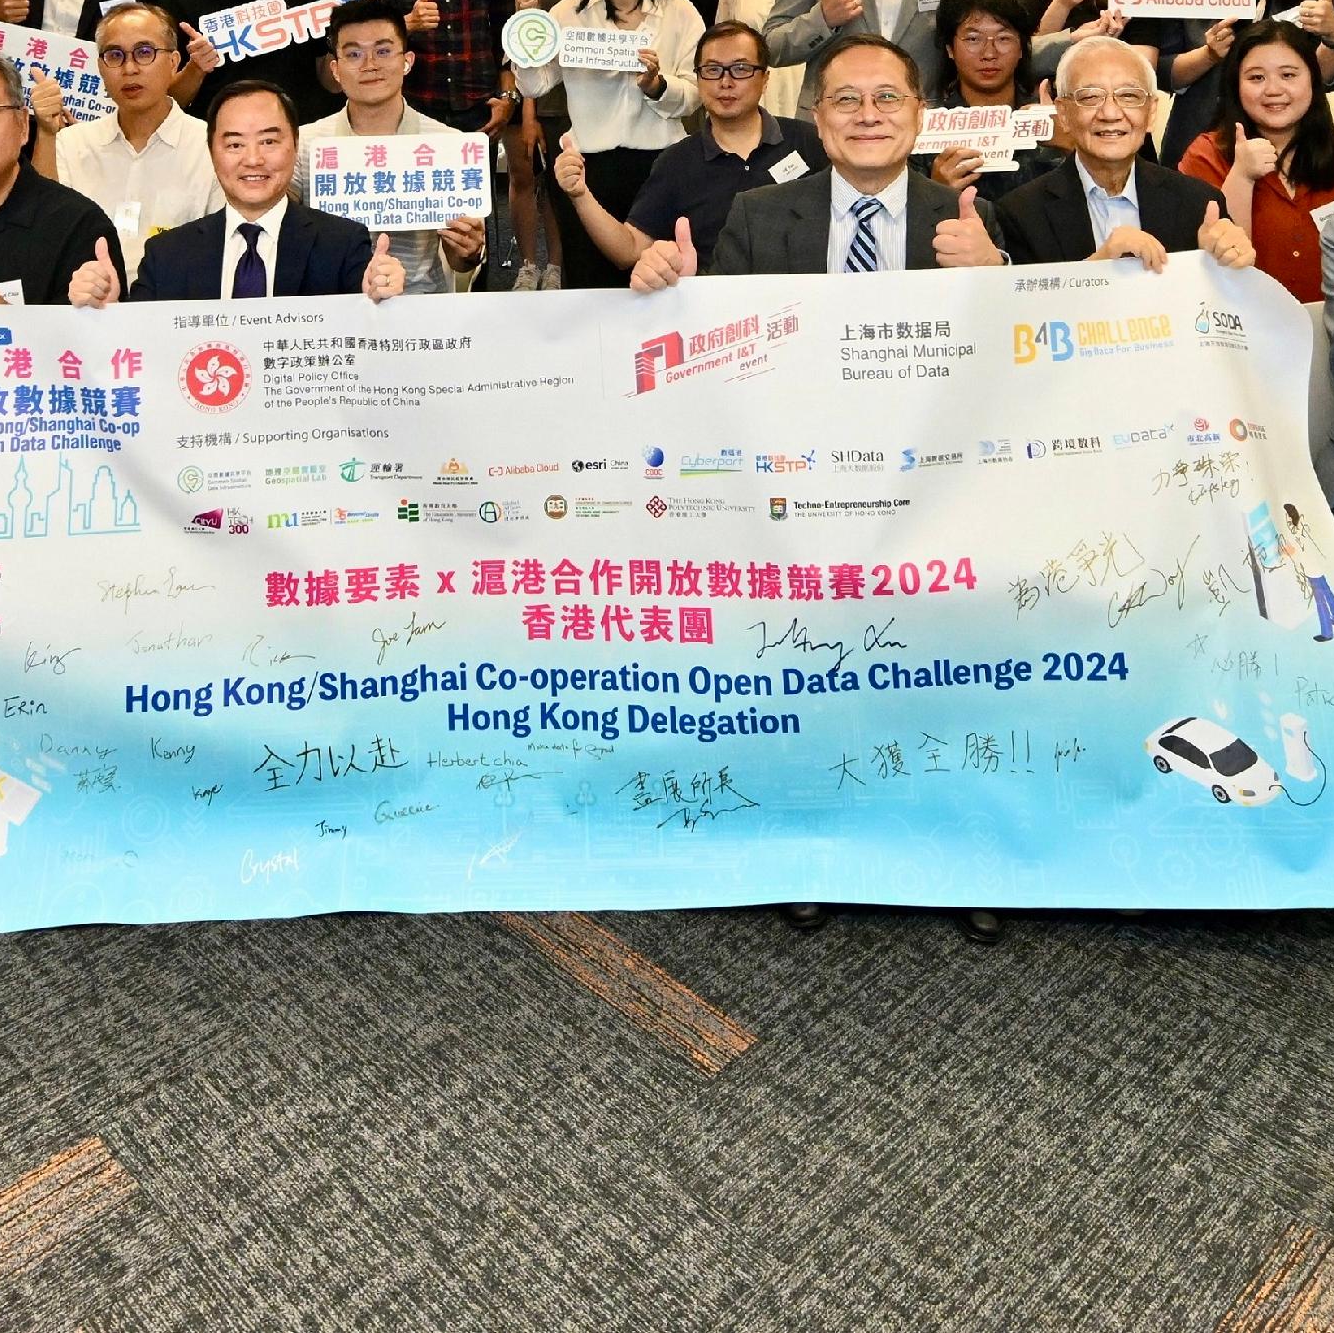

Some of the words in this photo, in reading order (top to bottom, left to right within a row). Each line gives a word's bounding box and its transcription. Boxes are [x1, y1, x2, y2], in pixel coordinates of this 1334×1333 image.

[204, 1, 281, 33] 香港科技園
[564, 44, 605, 56] Common
[607, 47, 637, 58] Spatia
[563, 55, 583, 65] Data
[927, 109, 1007, 131] 政府創科
[1012, 119, 1049, 138] 活動
[977, 136, 1000, 147] I&T
[315, 142, 485, 169] 滬港合作
[315, 168, 484, 197] 開放數據競賽
[318, 200, 350, 214] Hong
[354, 196, 444, 212] Kong/Shanghai
[447, 195, 483, 210] Co-op
[374, 211, 402, 226] Data
[1069, 276, 1110, 288] Curators
[174, 314, 229, 329] 指導單位
[240, 315, 272, 326] Event
[275, 313, 325, 325] Advisors
[1212, 311, 1243, 331] SODA
[689, 314, 760, 358] 政府創科
[766, 314, 799, 342] 活動
[839, 321, 952, 342] 上海市数据局
[263, 336, 472, 352] 中華人民共和國香港特別行政區政府
[840, 343, 909, 364] Shanghai
[913, 342, 978, 359] Municipal
[263, 354, 356, 370] 數字政策辦公室
[666, 353, 734, 384] Government
[737, 343, 757, 361] I&T
[739, 355, 768, 371] event
[263, 373, 294, 385] Digital
[298, 371, 328, 383] Policy
[331, 371, 359, 381] Office
[842, 365, 894, 382] Bureau
[897, 365, 912, 380] of
[916, 365, 950, 380] Data
[264, 386, 281, 396] The
[285, 384, 344, 395] Government
[347, 384, 357, 393] of
[358, 385, 372, 394] the
[373, 385, 399, 397] Hong
[401, 385, 426, 397] Kong
[428, 384, 464, 396] Special
[467, 377, 538, 392] Administrative
[539, 375, 574, 387] Region
[264, 399, 274, 408] of
[276, 398, 293, 407] the
[295, 395, 337, 409] People's
[339, 395, 379, 408] Republic
[380, 397, 391, 406] of
[392, 397, 420, 407] China
[99, 418, 141, 437] Co-op
[10, 435, 47, 453] Data
[51, 433, 122, 453] Challenge
[177, 433, 232, 449] 支持機構
[242, 431, 309, 445] Supporting
[311, 427, 389, 442] Organisations
[585, 459, 607, 471] esri
[681, 456, 744, 468] Cyberport
[831, 450, 884, 464] SHData
[505, 465, 535, 476] Alibaba
[536, 463, 559, 474] Cloud
[756, 461, 807, 474] HKSTP
[705, 497, 725, 505] KONG
[794, 499, 892, 510] Techno-Entrepreneurship
[229, 525, 249, 534] 300
[264, 563, 420, 608] 數據要素
[471, 557, 978, 602] 滬港合作開放數據競賽2024
[522, 603, 714, 645] 香港代表團
[126, 683, 213, 716] Hong
[223, 662, 467, 711] Kong/Shanghai
[475, 663, 680, 699] Co-operation
[689, 668, 772, 702] Open
[783, 667, 860, 696] Data
[867, 657, 1032, 691] Challenge
[1042, 651, 1130, 682] 2024
[448, 702, 531, 739] Hong
[540, 701, 620, 740] Kong
[628, 703, 800, 744] Delegation
[252, 733, 408, 792] 全力以赴
